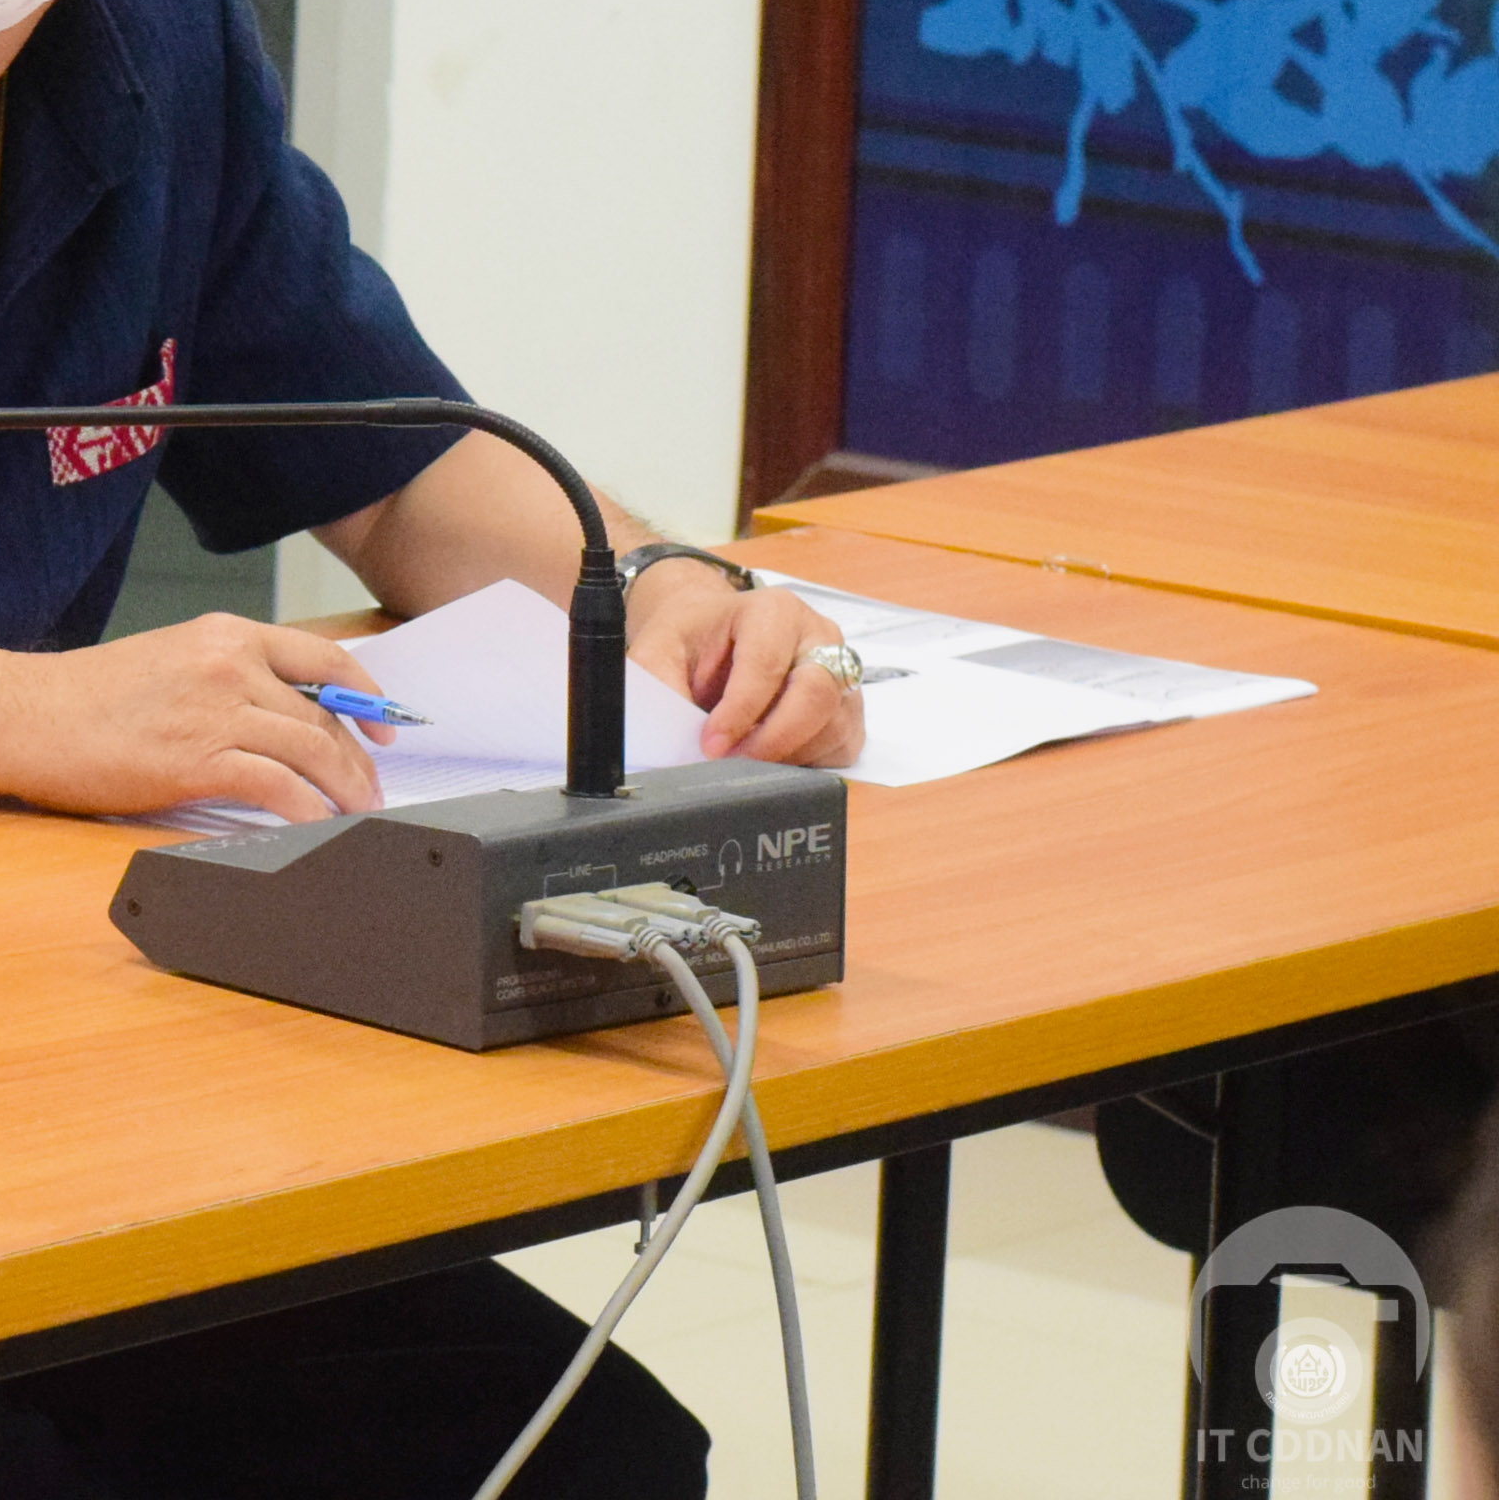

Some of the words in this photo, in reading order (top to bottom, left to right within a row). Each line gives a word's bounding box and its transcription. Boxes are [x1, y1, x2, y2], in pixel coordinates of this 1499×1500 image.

[756, 823, 832, 861] NPE
[639, 843, 708, 866] HEADPHONES
[756, 854, 832, 872] RESEARCH
[569, 865, 593, 878] LINE
